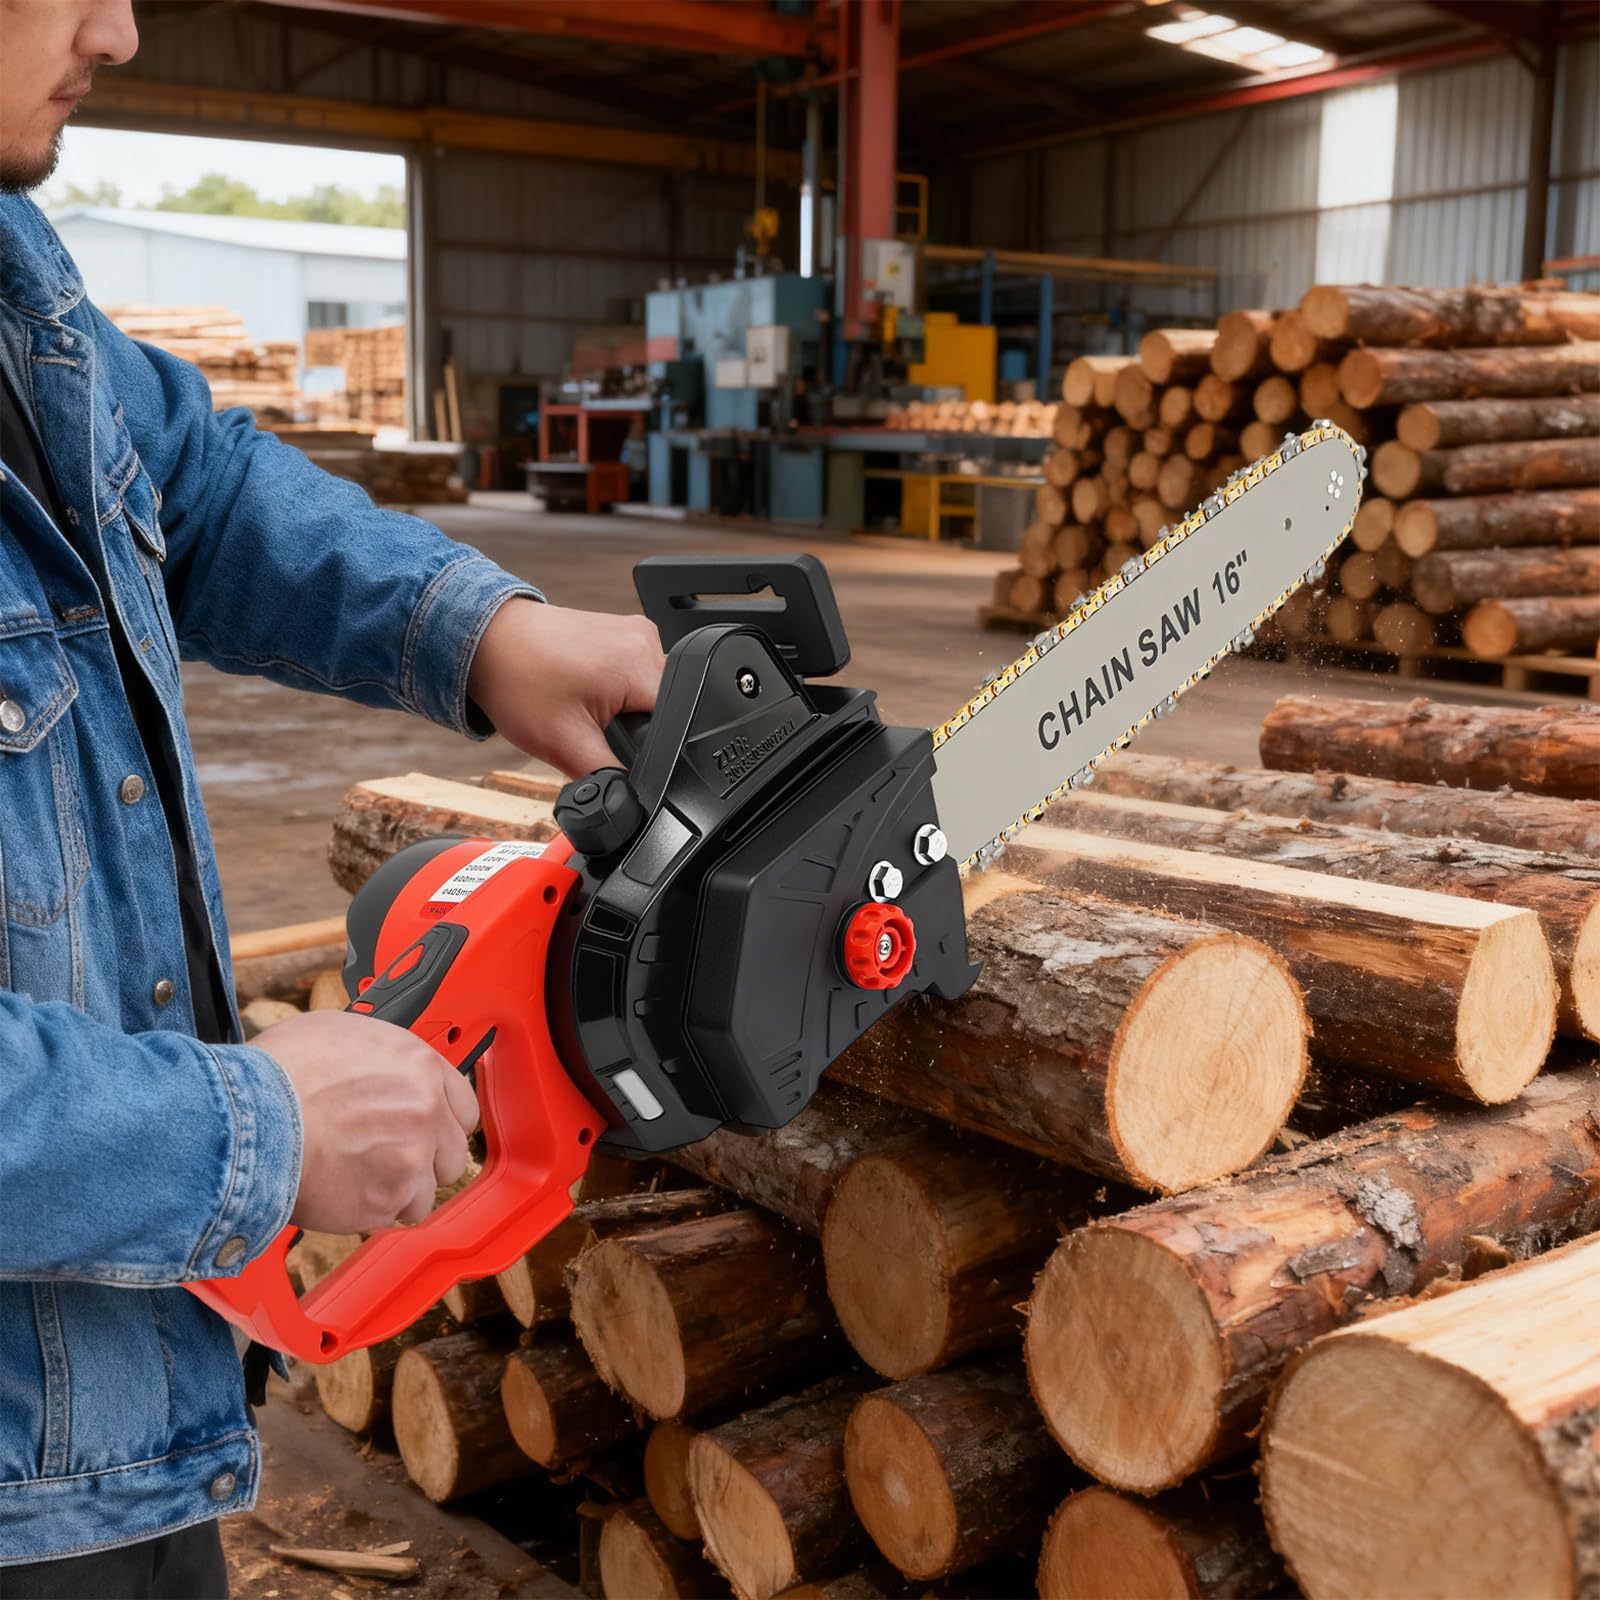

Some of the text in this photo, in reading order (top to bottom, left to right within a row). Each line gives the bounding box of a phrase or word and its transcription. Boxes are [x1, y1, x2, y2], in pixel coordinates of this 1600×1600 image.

[1037, 550, 1248, 751] CHAIN SAW 16"
